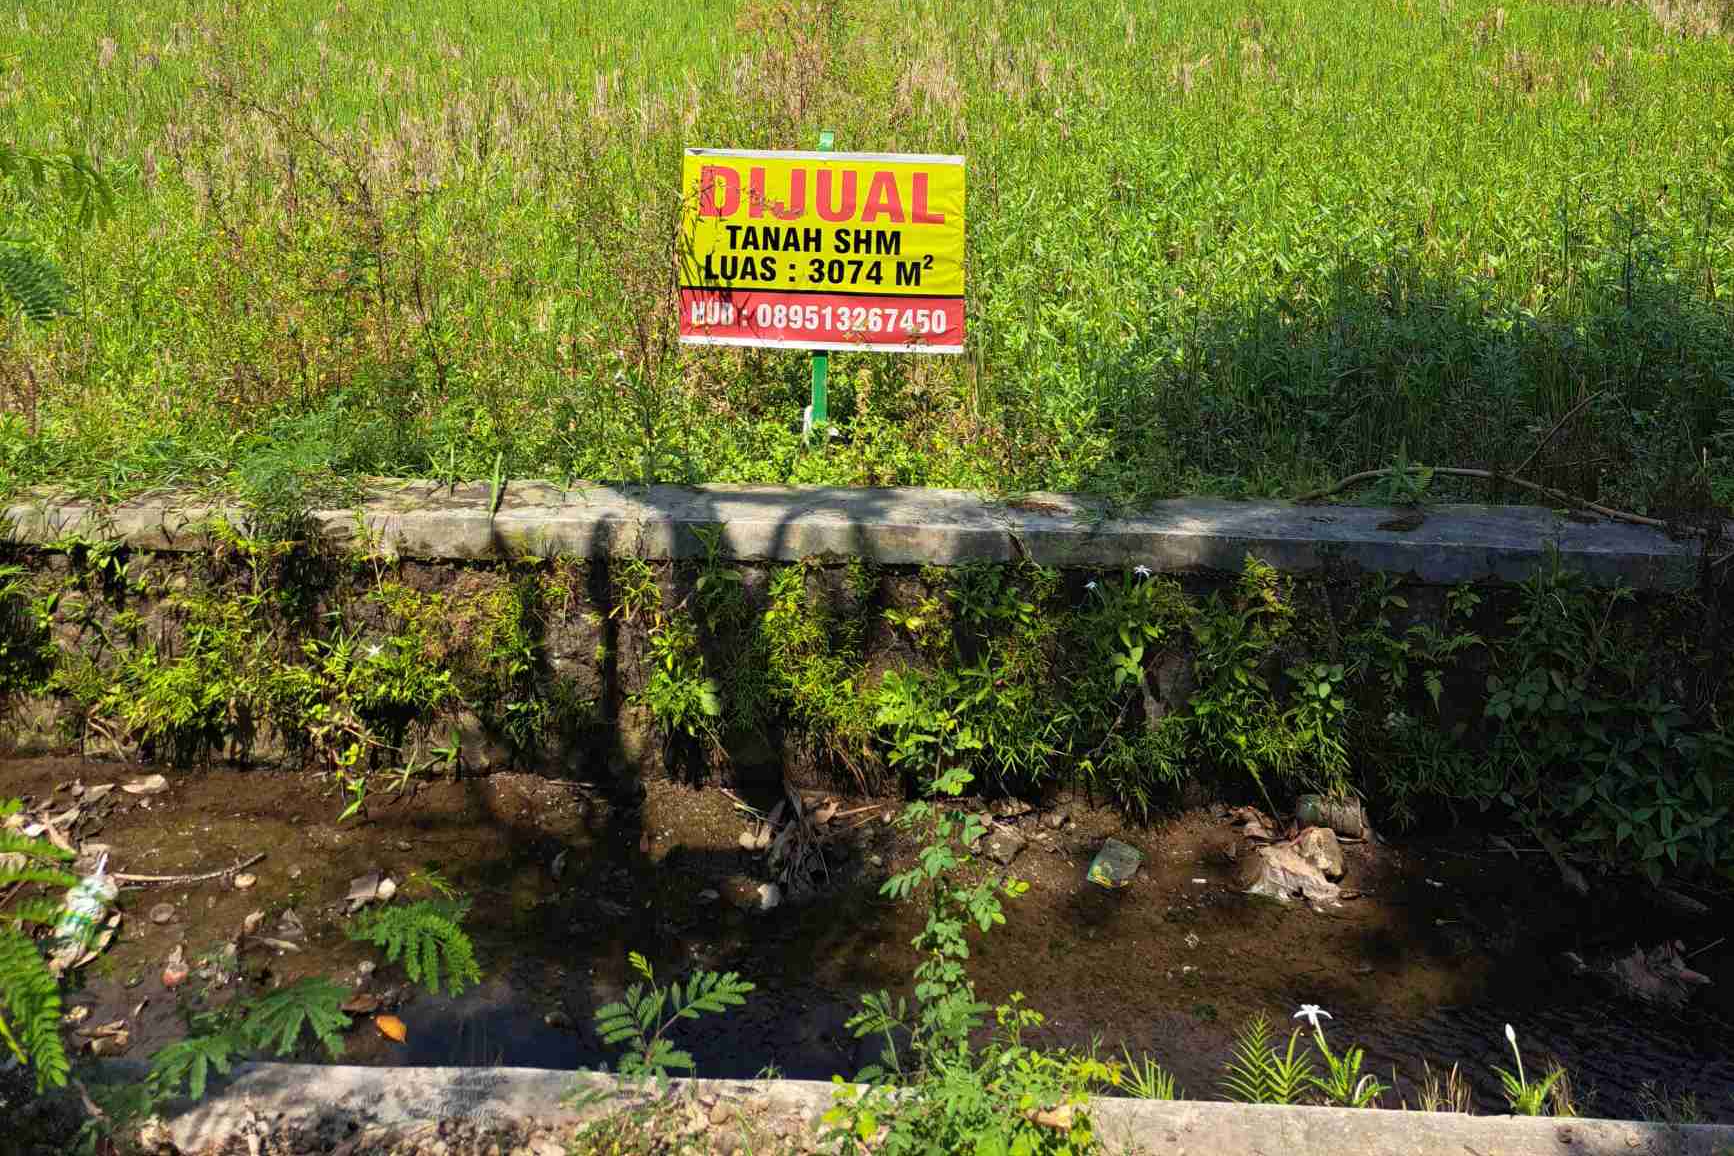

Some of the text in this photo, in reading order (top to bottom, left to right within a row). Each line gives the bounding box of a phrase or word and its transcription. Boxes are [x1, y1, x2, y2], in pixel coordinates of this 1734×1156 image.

[699, 164, 945, 225] DIJUAL
[726, 225, 901, 255] TANAH SHM
[704, 254, 776, 281] LUAS
[808, 260, 883, 285] 3074
[757, 303, 947, 334] 089513267450
